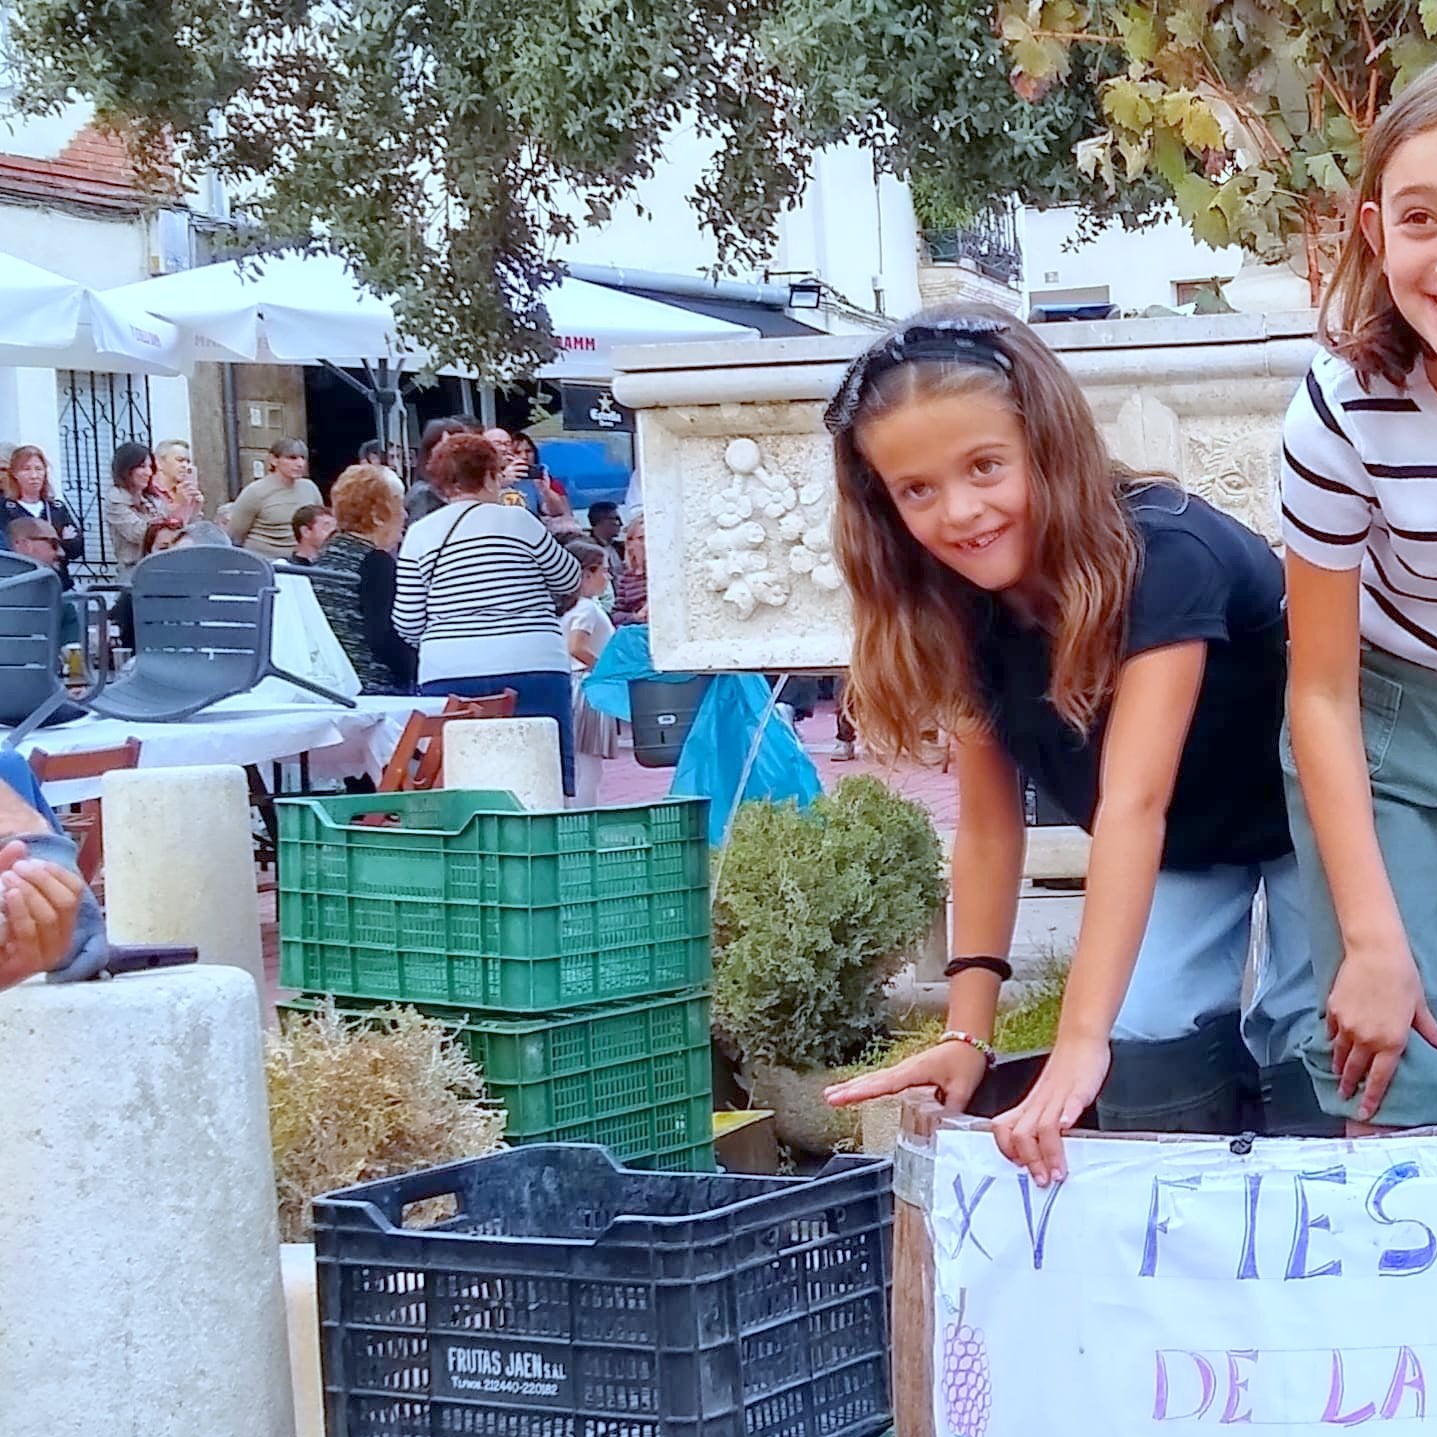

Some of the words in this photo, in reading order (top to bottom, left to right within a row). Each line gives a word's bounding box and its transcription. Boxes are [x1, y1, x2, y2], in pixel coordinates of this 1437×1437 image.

[951, 1173, 1070, 1270] XV
[447, 1346, 502, 1376] FRUTAS
[504, 1351, 543, 1379] JAEN
[1152, 1348, 1260, 1424] DE
[1321, 1345, 1427, 1427] LA
